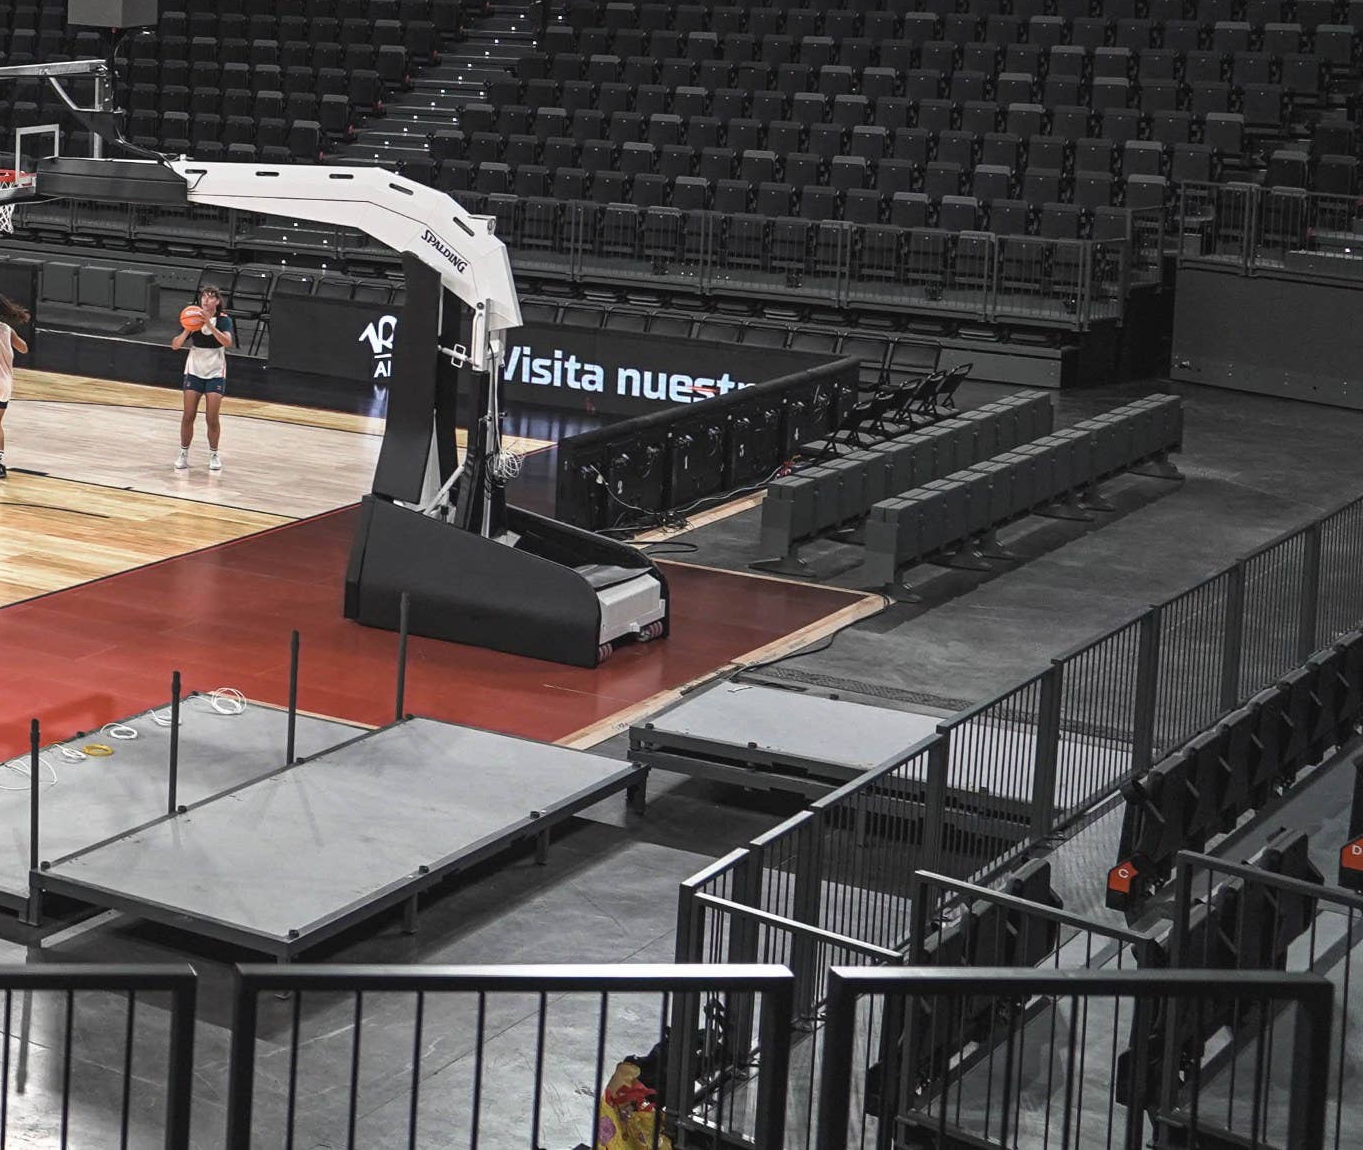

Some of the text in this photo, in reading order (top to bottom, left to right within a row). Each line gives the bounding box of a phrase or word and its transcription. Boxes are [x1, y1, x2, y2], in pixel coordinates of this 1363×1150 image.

[421, 229, 468, 274] SPALDING
[502, 345, 756, 403] Visita nuest
[1351, 844, 1363, 856] D
[1118, 868, 1129, 879] C
